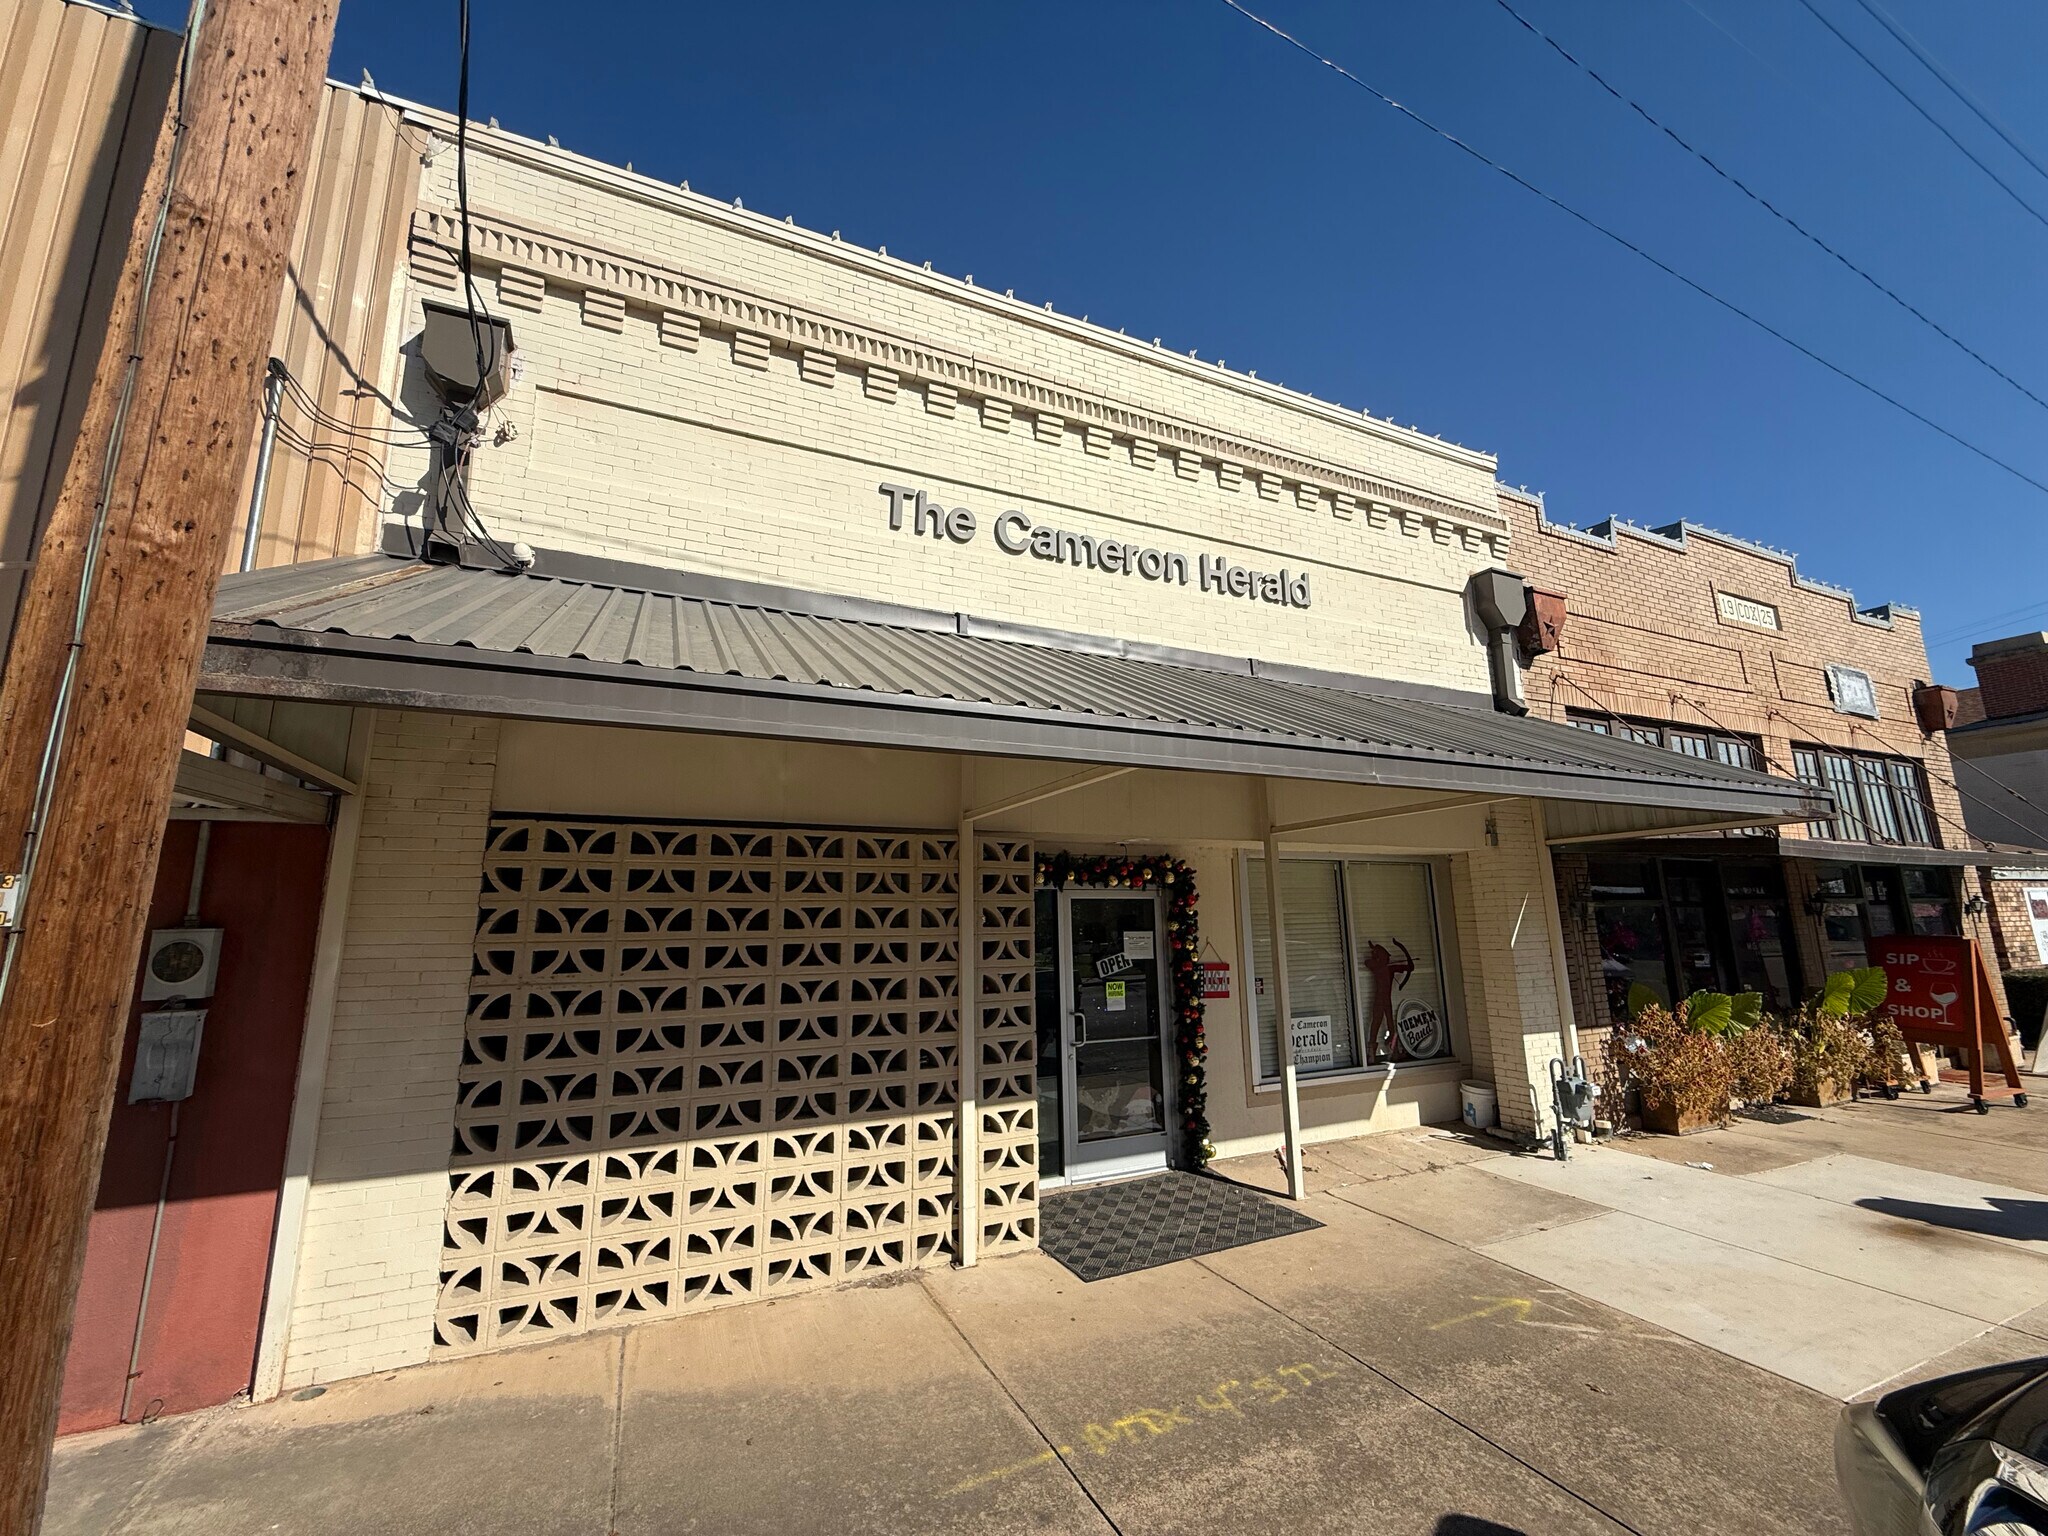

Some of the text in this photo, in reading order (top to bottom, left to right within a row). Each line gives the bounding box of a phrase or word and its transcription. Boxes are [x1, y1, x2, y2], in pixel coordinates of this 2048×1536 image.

[878, 482, 1311, 608] The Cameron Herald
[1722, 598, 1774, 626] 19 COX 25
[1100, 953, 1131, 975] OPEN
[1886, 953, 1919, 965] SIP
[1895, 978, 1912, 992] &
[1888, 1003, 1944, 1019] SHOP
[1297, 1020, 1328, 1030] Cameron
[1398, 1010, 1437, 1033] YOEMEN
[1407, 1022, 1433, 1046] Band
[1293, 1053, 1331, 1066] Champion
